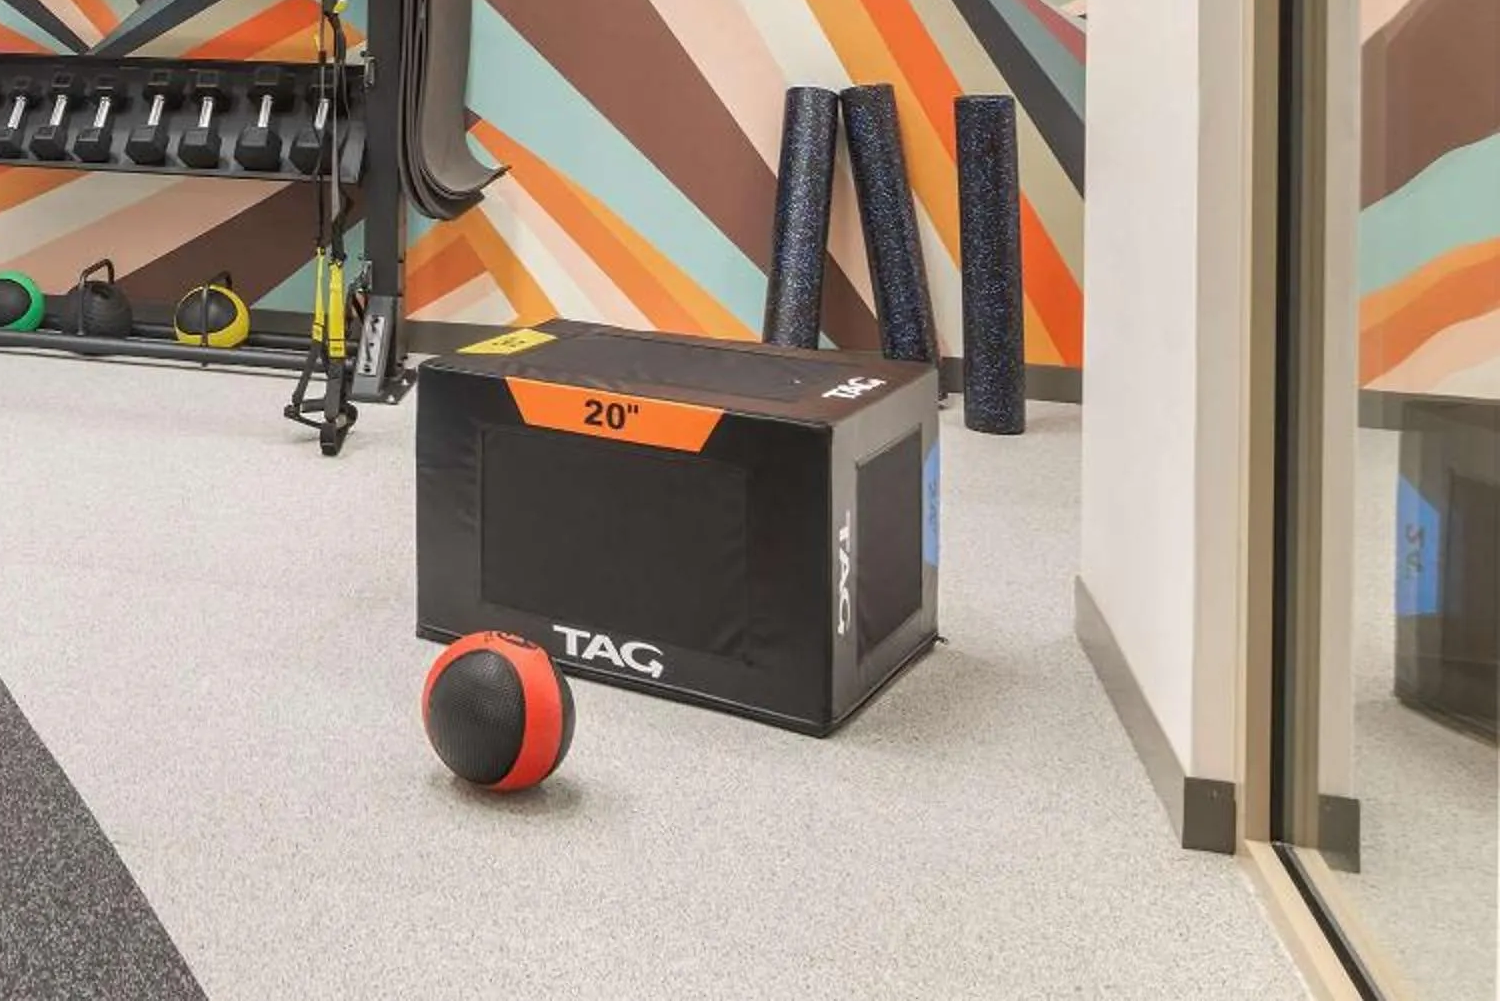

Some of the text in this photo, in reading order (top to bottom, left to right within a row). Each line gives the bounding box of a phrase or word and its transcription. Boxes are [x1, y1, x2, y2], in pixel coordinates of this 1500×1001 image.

[583, 397, 639, 431] 20"
[837, 508, 851, 635] TAG
[551, 623, 665, 679] TAG
